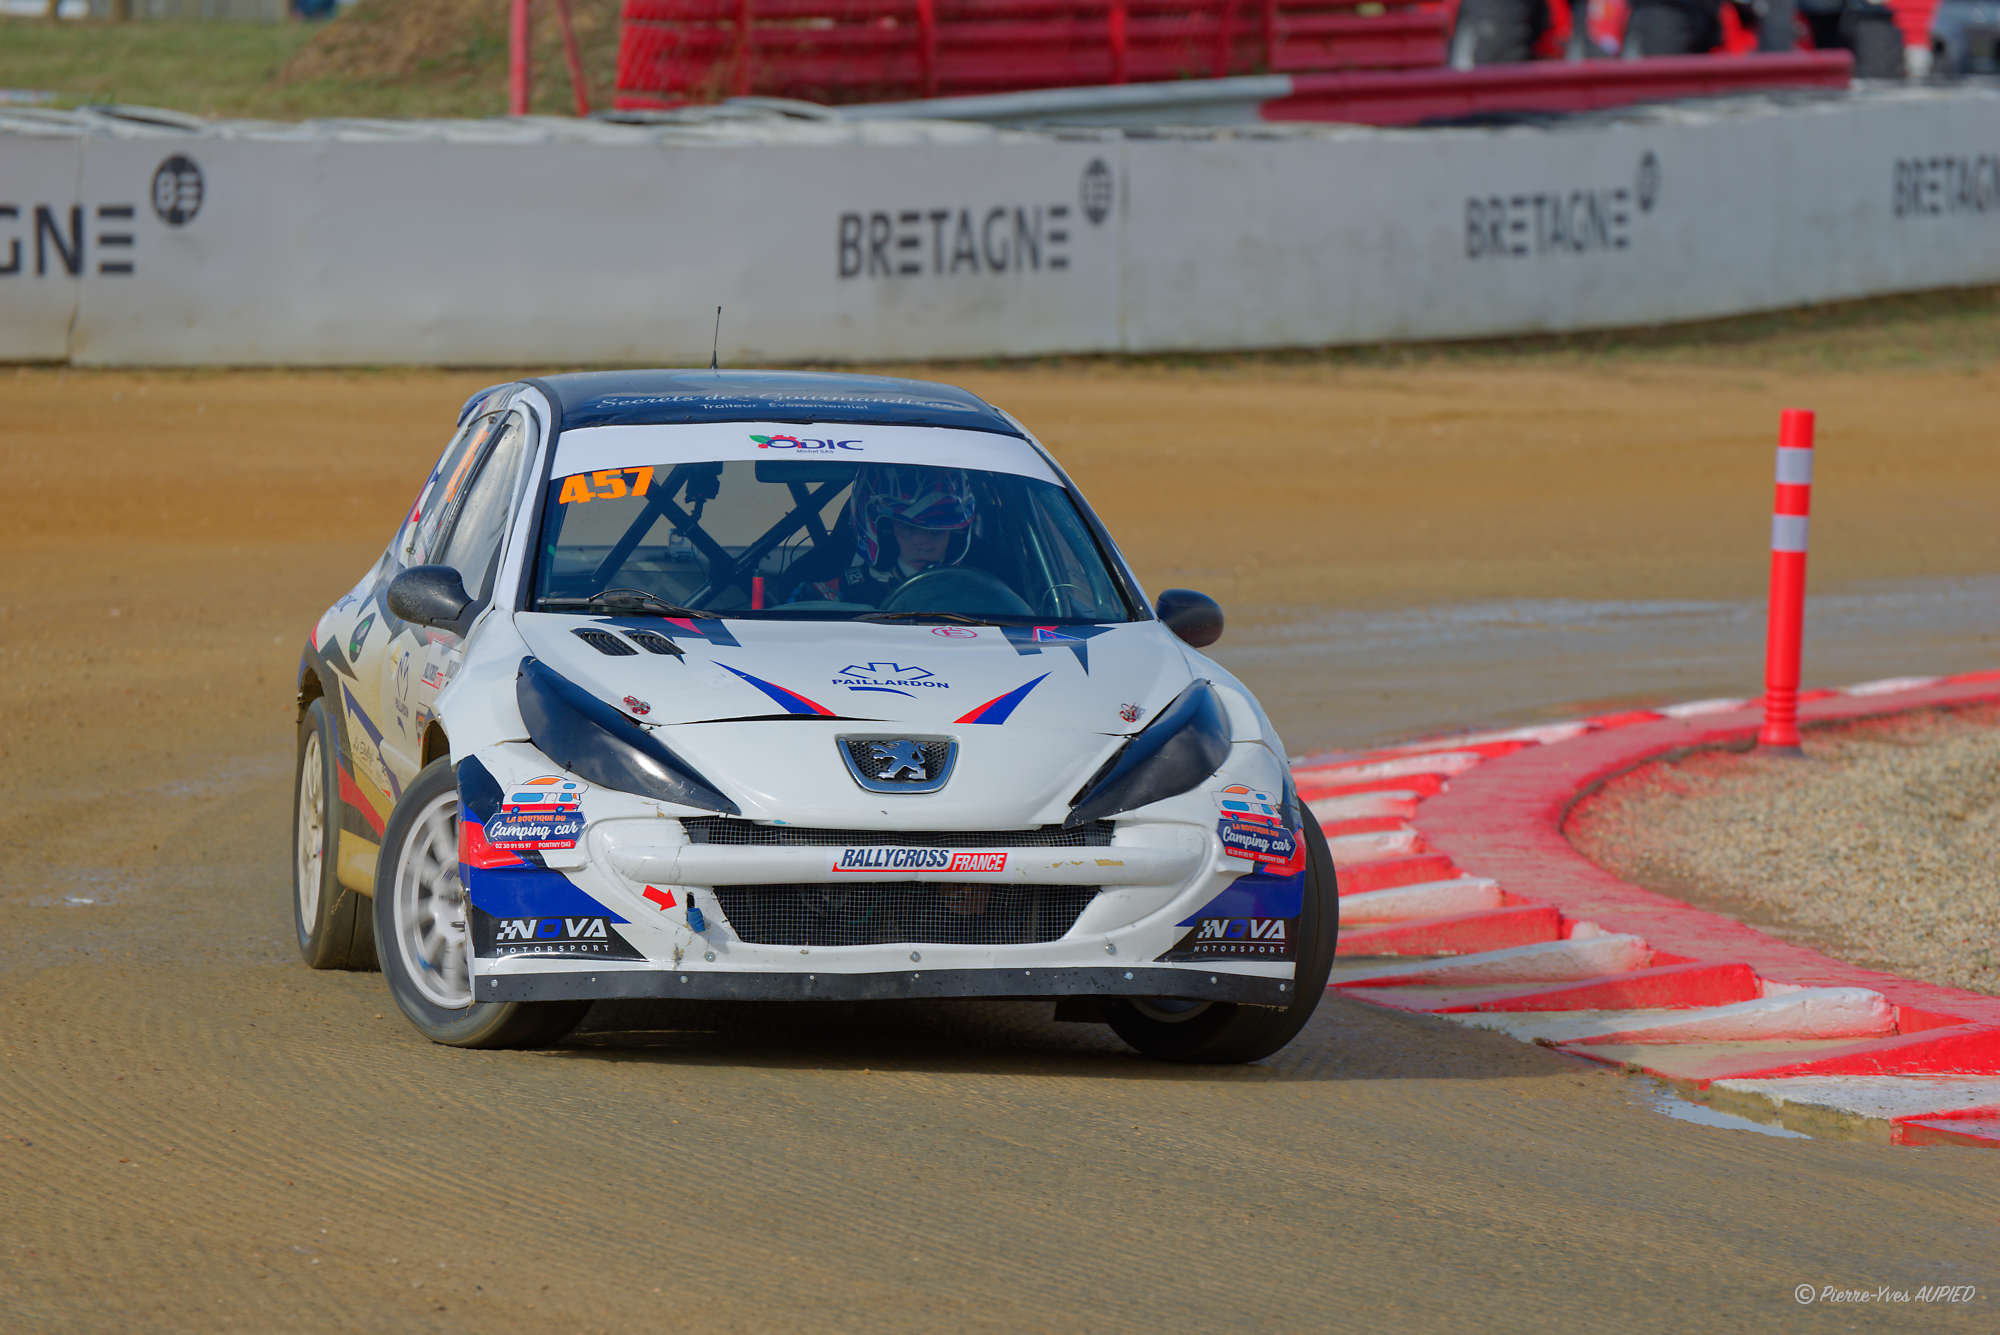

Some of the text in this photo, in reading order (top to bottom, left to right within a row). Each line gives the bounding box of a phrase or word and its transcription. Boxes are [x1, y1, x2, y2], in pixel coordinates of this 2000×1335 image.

[1466, 189, 1628, 258] BRETAGNE
[838, 206, 1070, 279] BRETAGNE
[767, 438, 865, 451] ODIC
[558, 466, 655, 505] 457
[831, 678, 950, 689] PAILLARDON
[517, 815, 554, 823] BOUTIQUE
[555, 814, 566, 822] DU
[490, 821, 579, 840] Camping car
[1222, 826, 1292, 852] Camping car
[840, 848, 1006, 871] RALLYCROSS FRANCE
[494, 918, 608, 940] NOVA
[1197, 919, 1287, 939] NOVA
[496, 944, 609, 955] MOTORSPORT
[1193, 945, 1287, 954] MOTORSPORT
